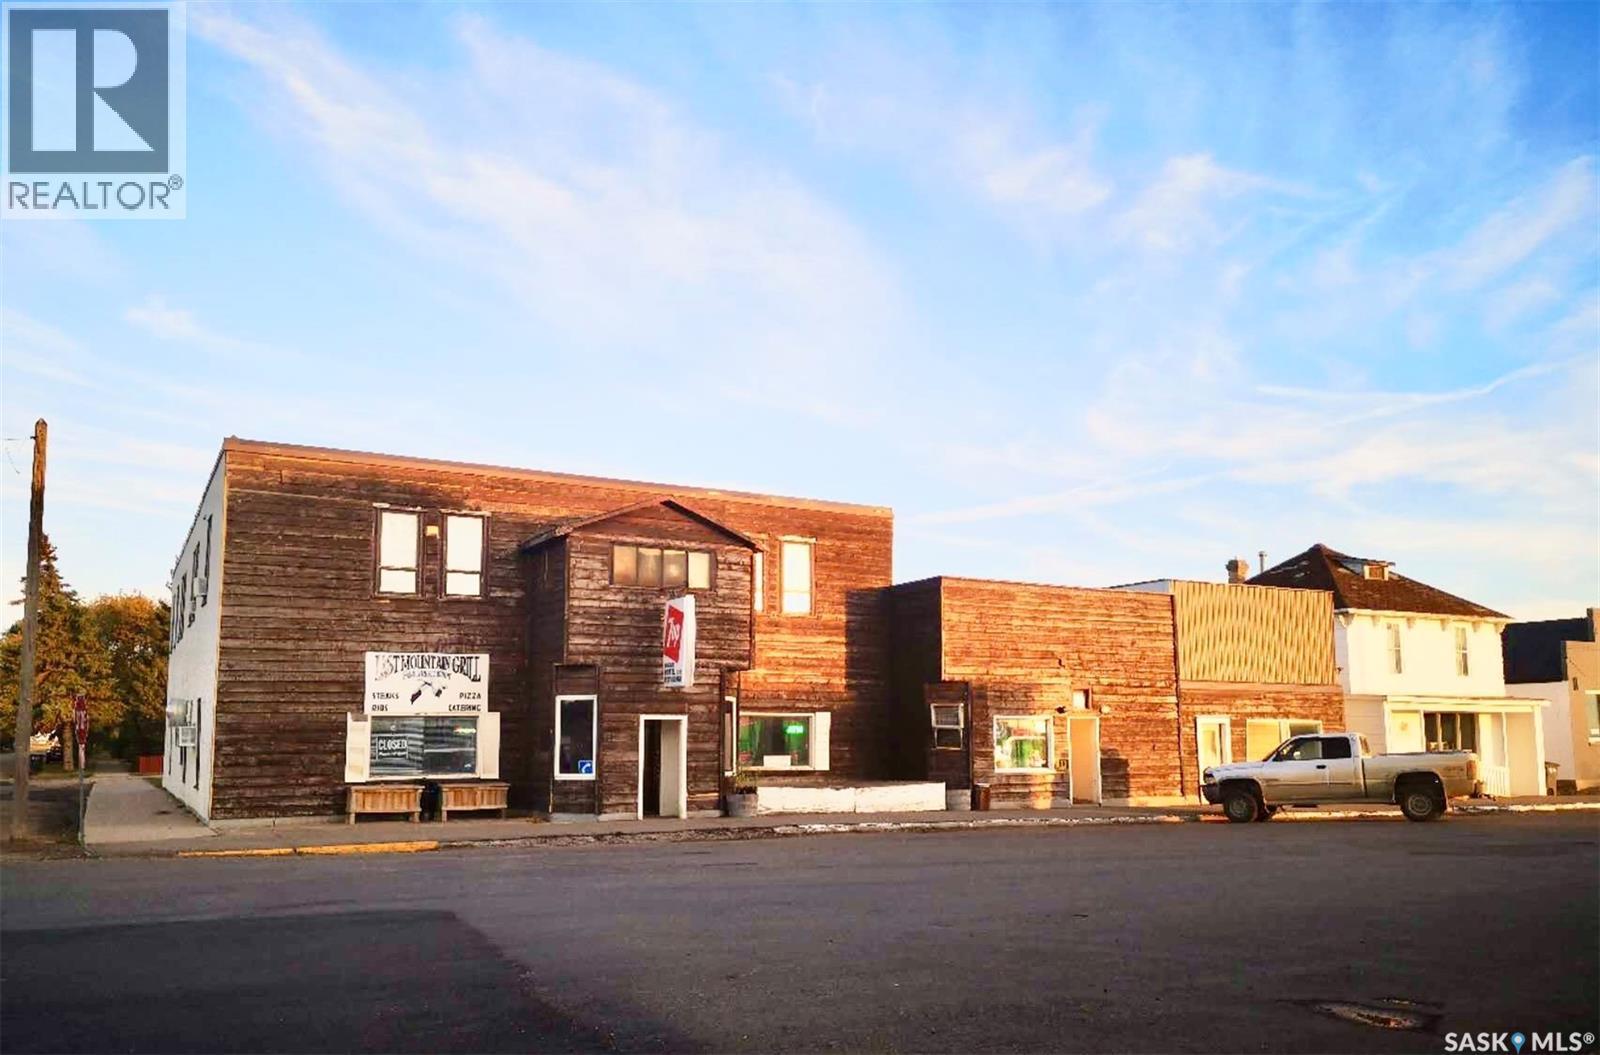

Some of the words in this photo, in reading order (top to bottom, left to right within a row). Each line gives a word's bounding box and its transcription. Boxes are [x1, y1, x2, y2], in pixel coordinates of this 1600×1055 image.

[401, 655, 451, 670] MOUNTAIN
[452, 656, 481, 682] GRILL
[448, 704, 482, 712] CATERING
[379, 739, 407, 751] CLOSED
